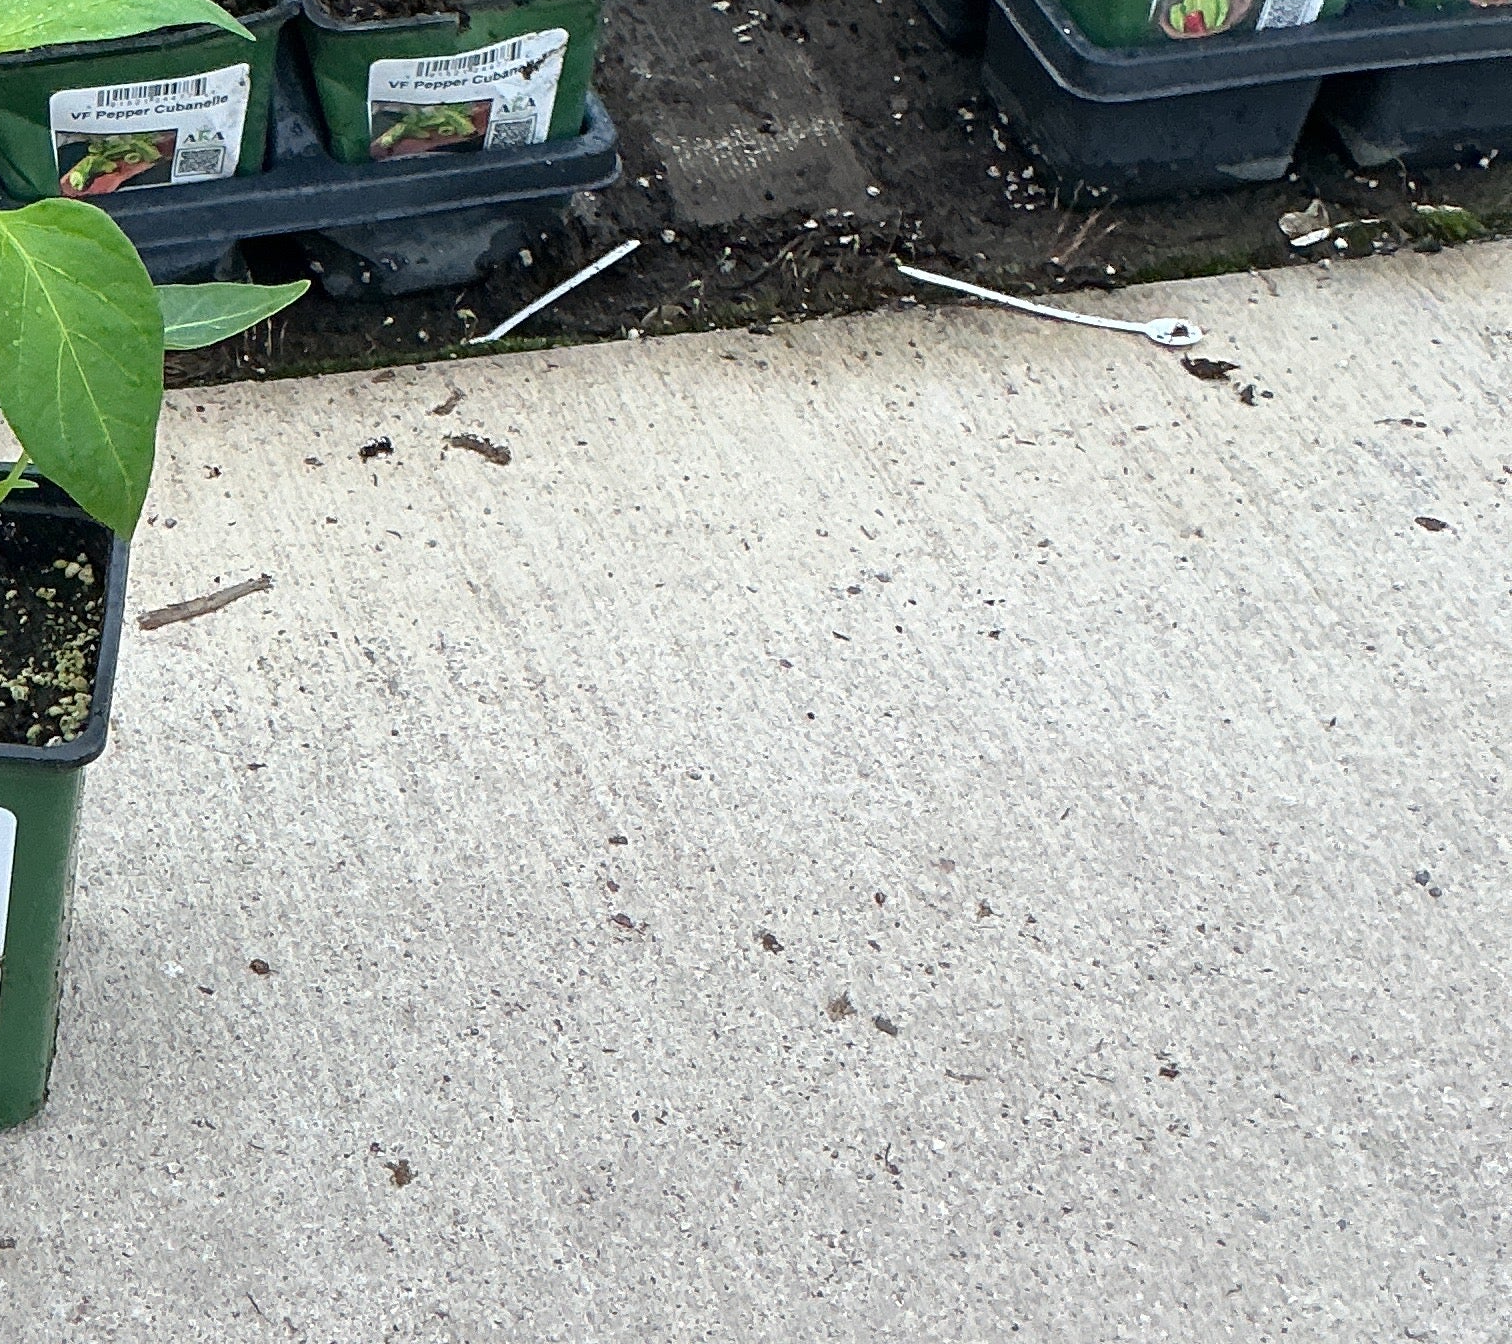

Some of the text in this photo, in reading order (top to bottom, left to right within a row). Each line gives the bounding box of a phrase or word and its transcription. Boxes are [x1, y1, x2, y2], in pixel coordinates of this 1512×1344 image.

[389, 80, 409, 89] VF
[414, 78, 468, 90] Pepper
[71, 112, 91, 120] VF
[96, 108, 150, 120] Pepper
[155, 95, 228, 114] Cubanelle
